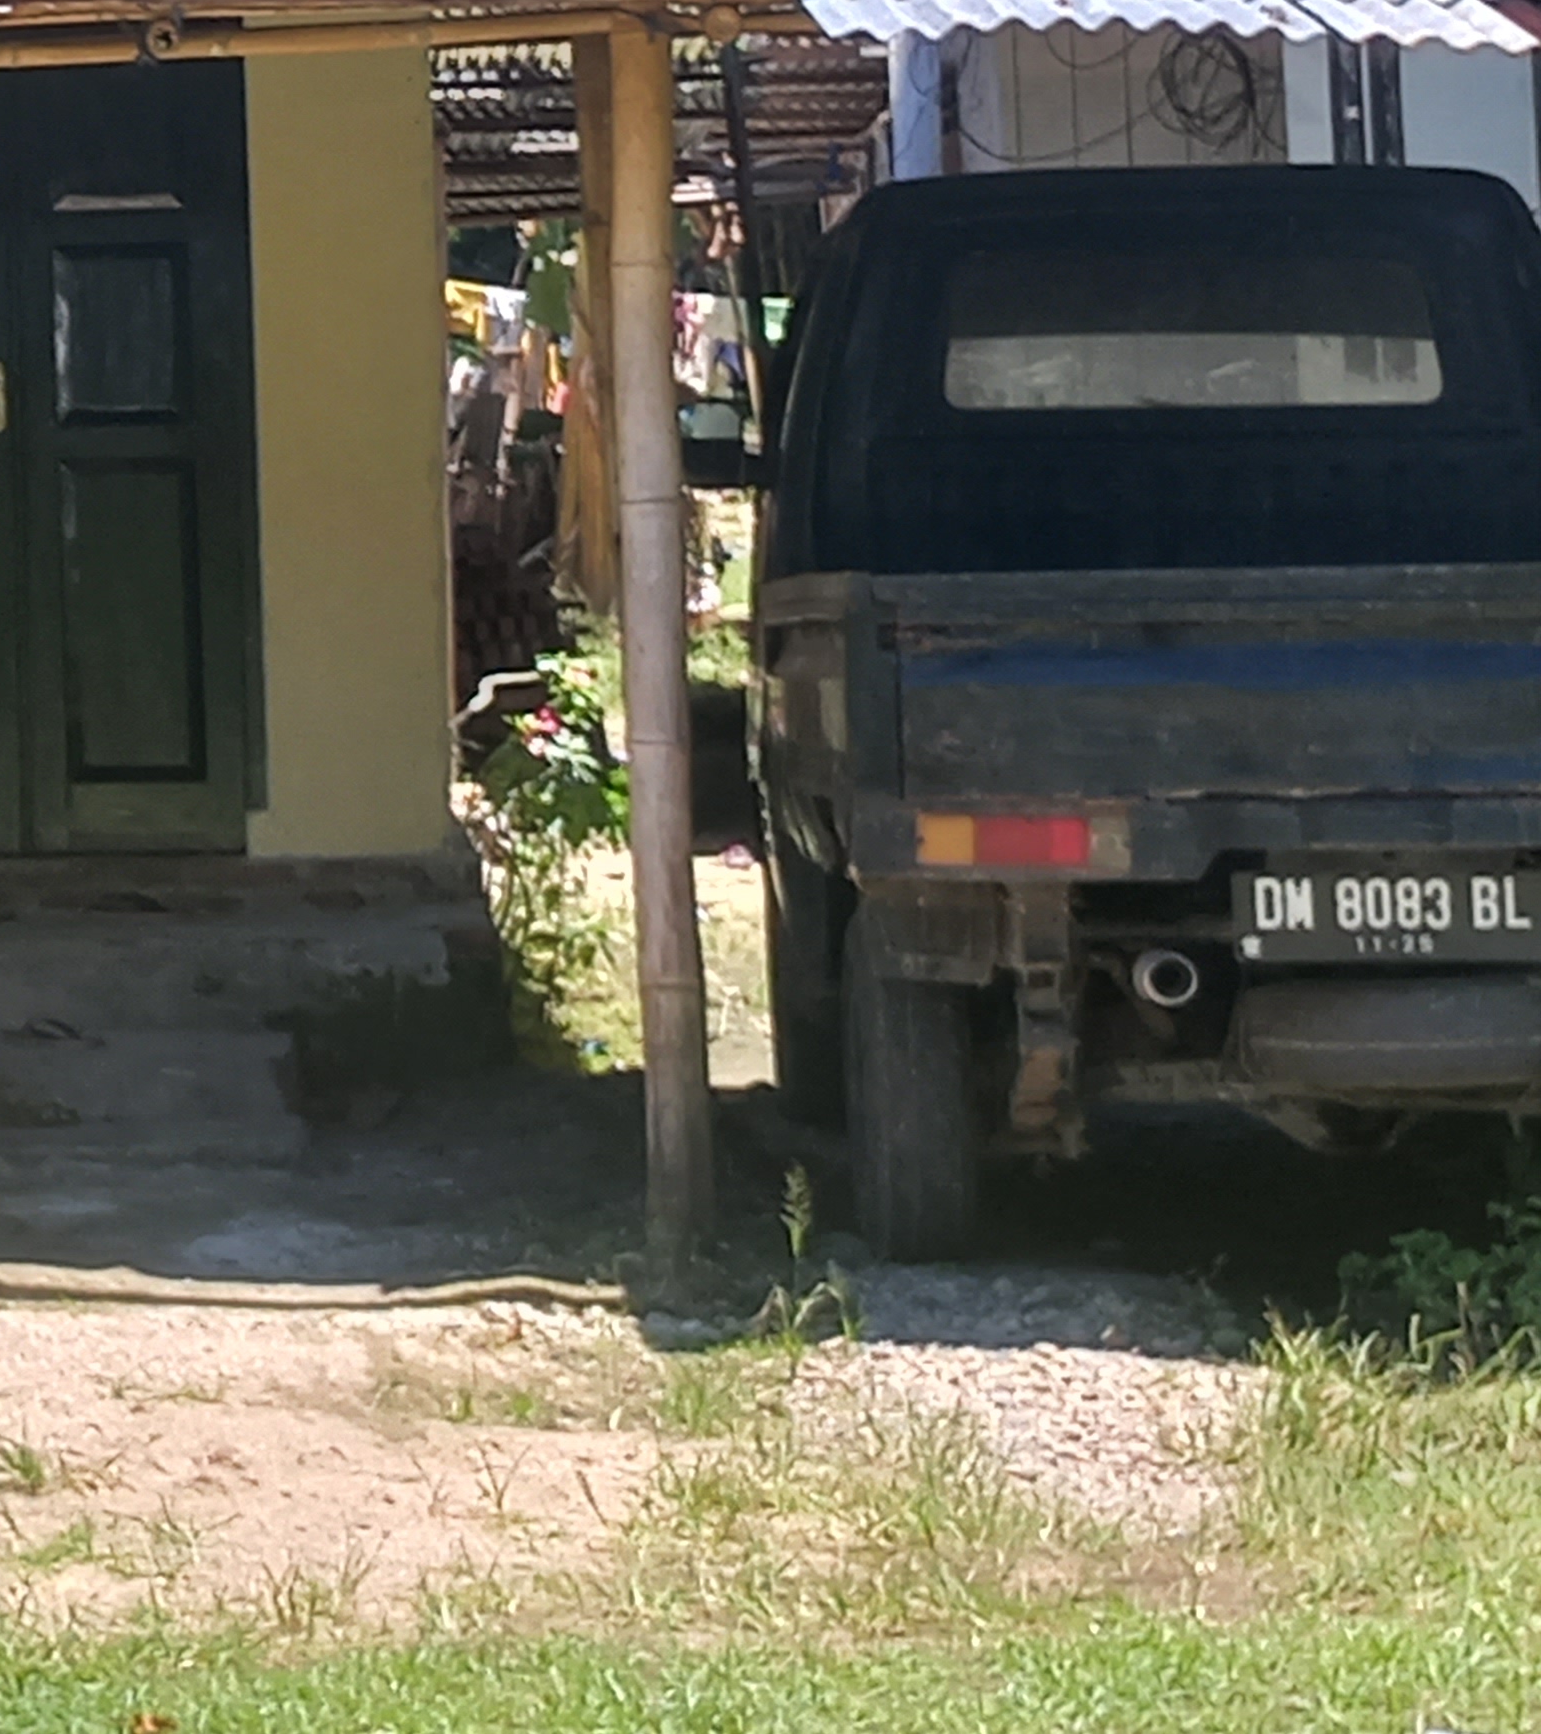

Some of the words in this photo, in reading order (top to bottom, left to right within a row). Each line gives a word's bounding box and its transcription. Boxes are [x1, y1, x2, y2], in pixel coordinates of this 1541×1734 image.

[1253, 876, 1315, 930] DM
[1334, 876, 1452, 931] 8083
[1470, 874, 1533, 930] BL
